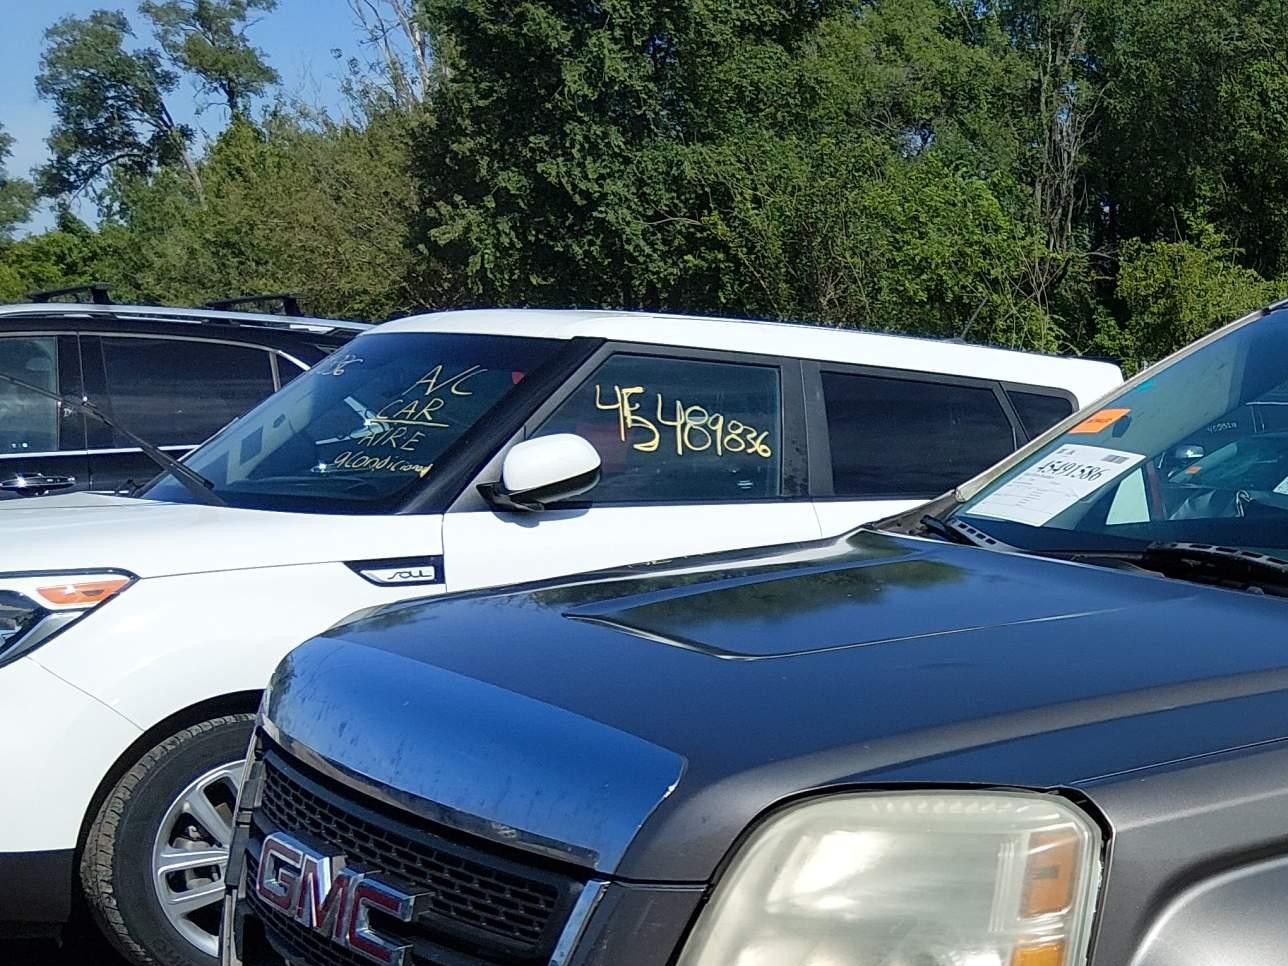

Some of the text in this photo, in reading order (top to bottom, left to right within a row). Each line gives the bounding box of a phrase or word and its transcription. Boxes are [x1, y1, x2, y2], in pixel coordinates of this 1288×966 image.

[402, 365, 488, 396] A/C
[375, 397, 445, 421] CAR
[595, 384, 772, 459] 45489836
